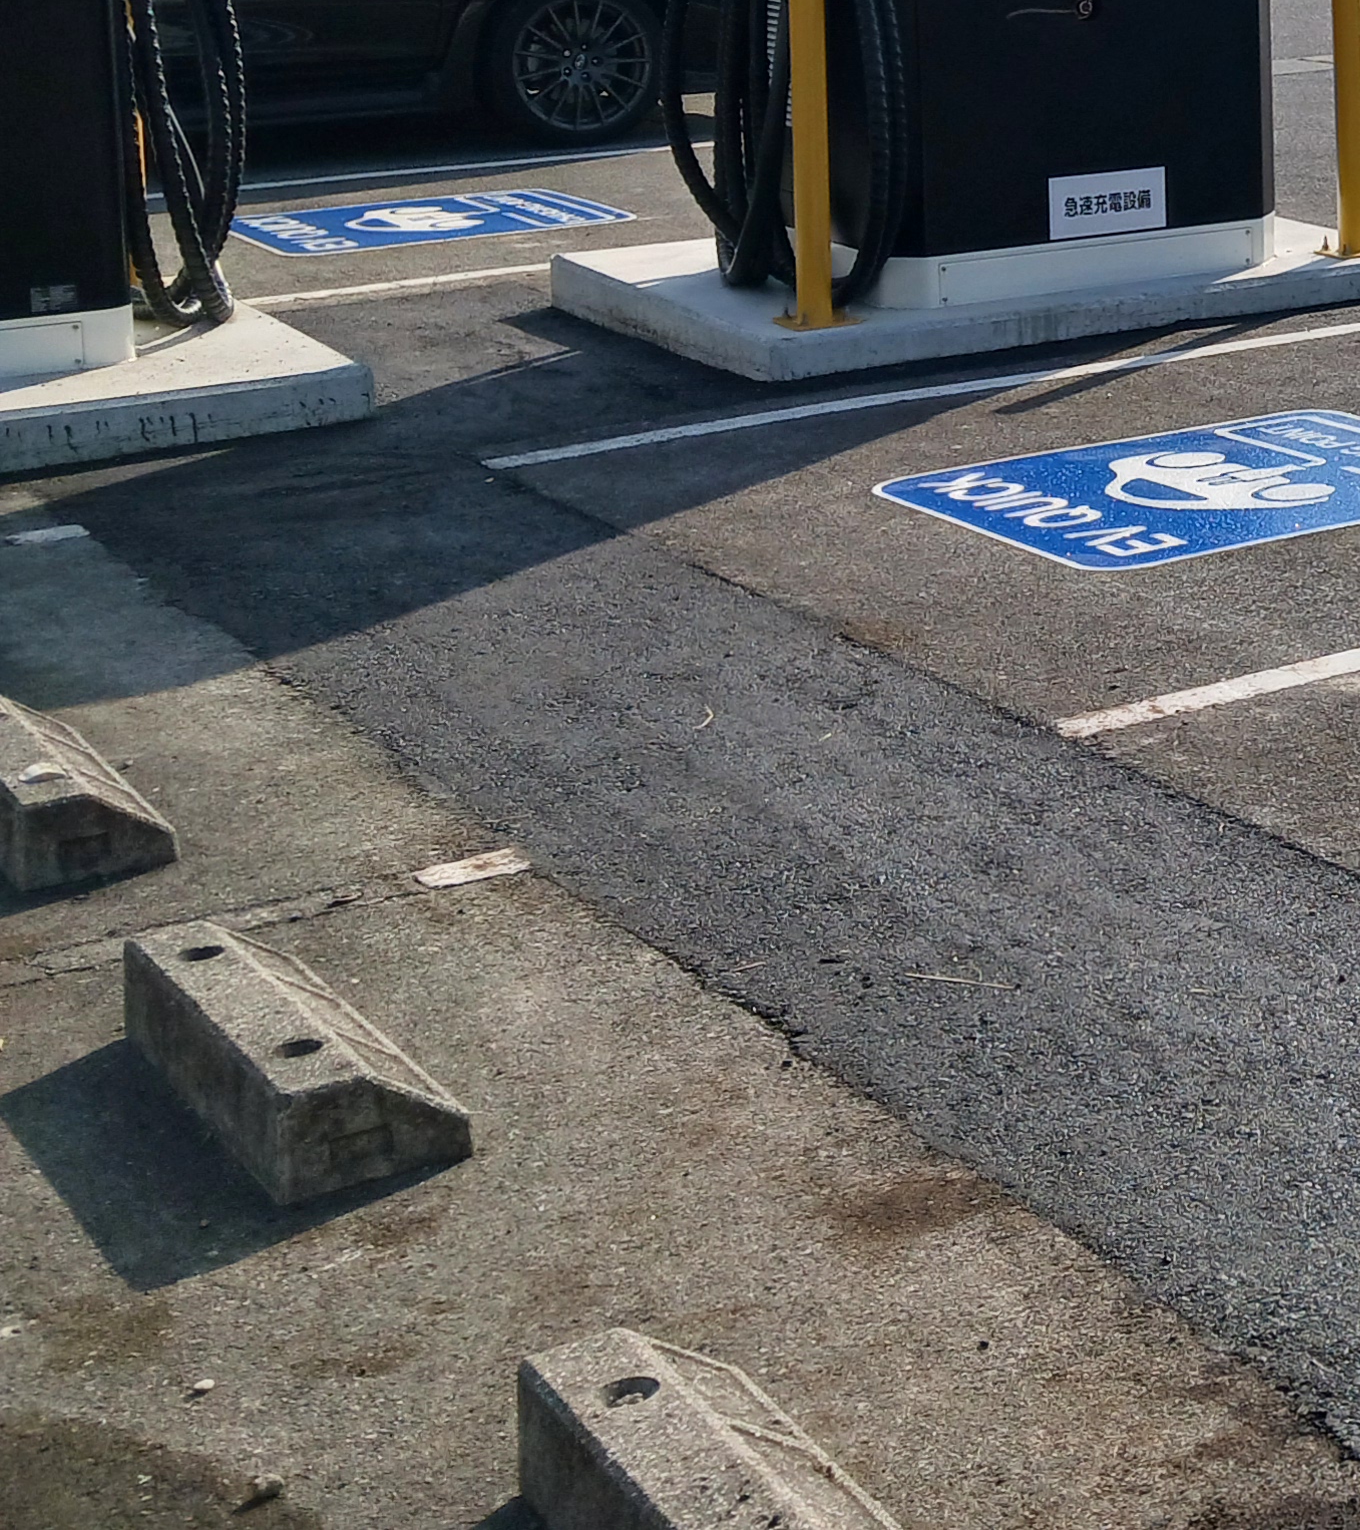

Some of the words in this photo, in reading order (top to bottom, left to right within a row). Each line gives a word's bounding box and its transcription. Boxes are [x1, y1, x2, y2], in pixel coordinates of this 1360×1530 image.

[1064, 189, 1152, 218] 急速充電設備
[1257, 425, 1354, 449] POINT
[917, 472, 1102, 528] QUICK
[1062, 525, 1189, 557] EV
